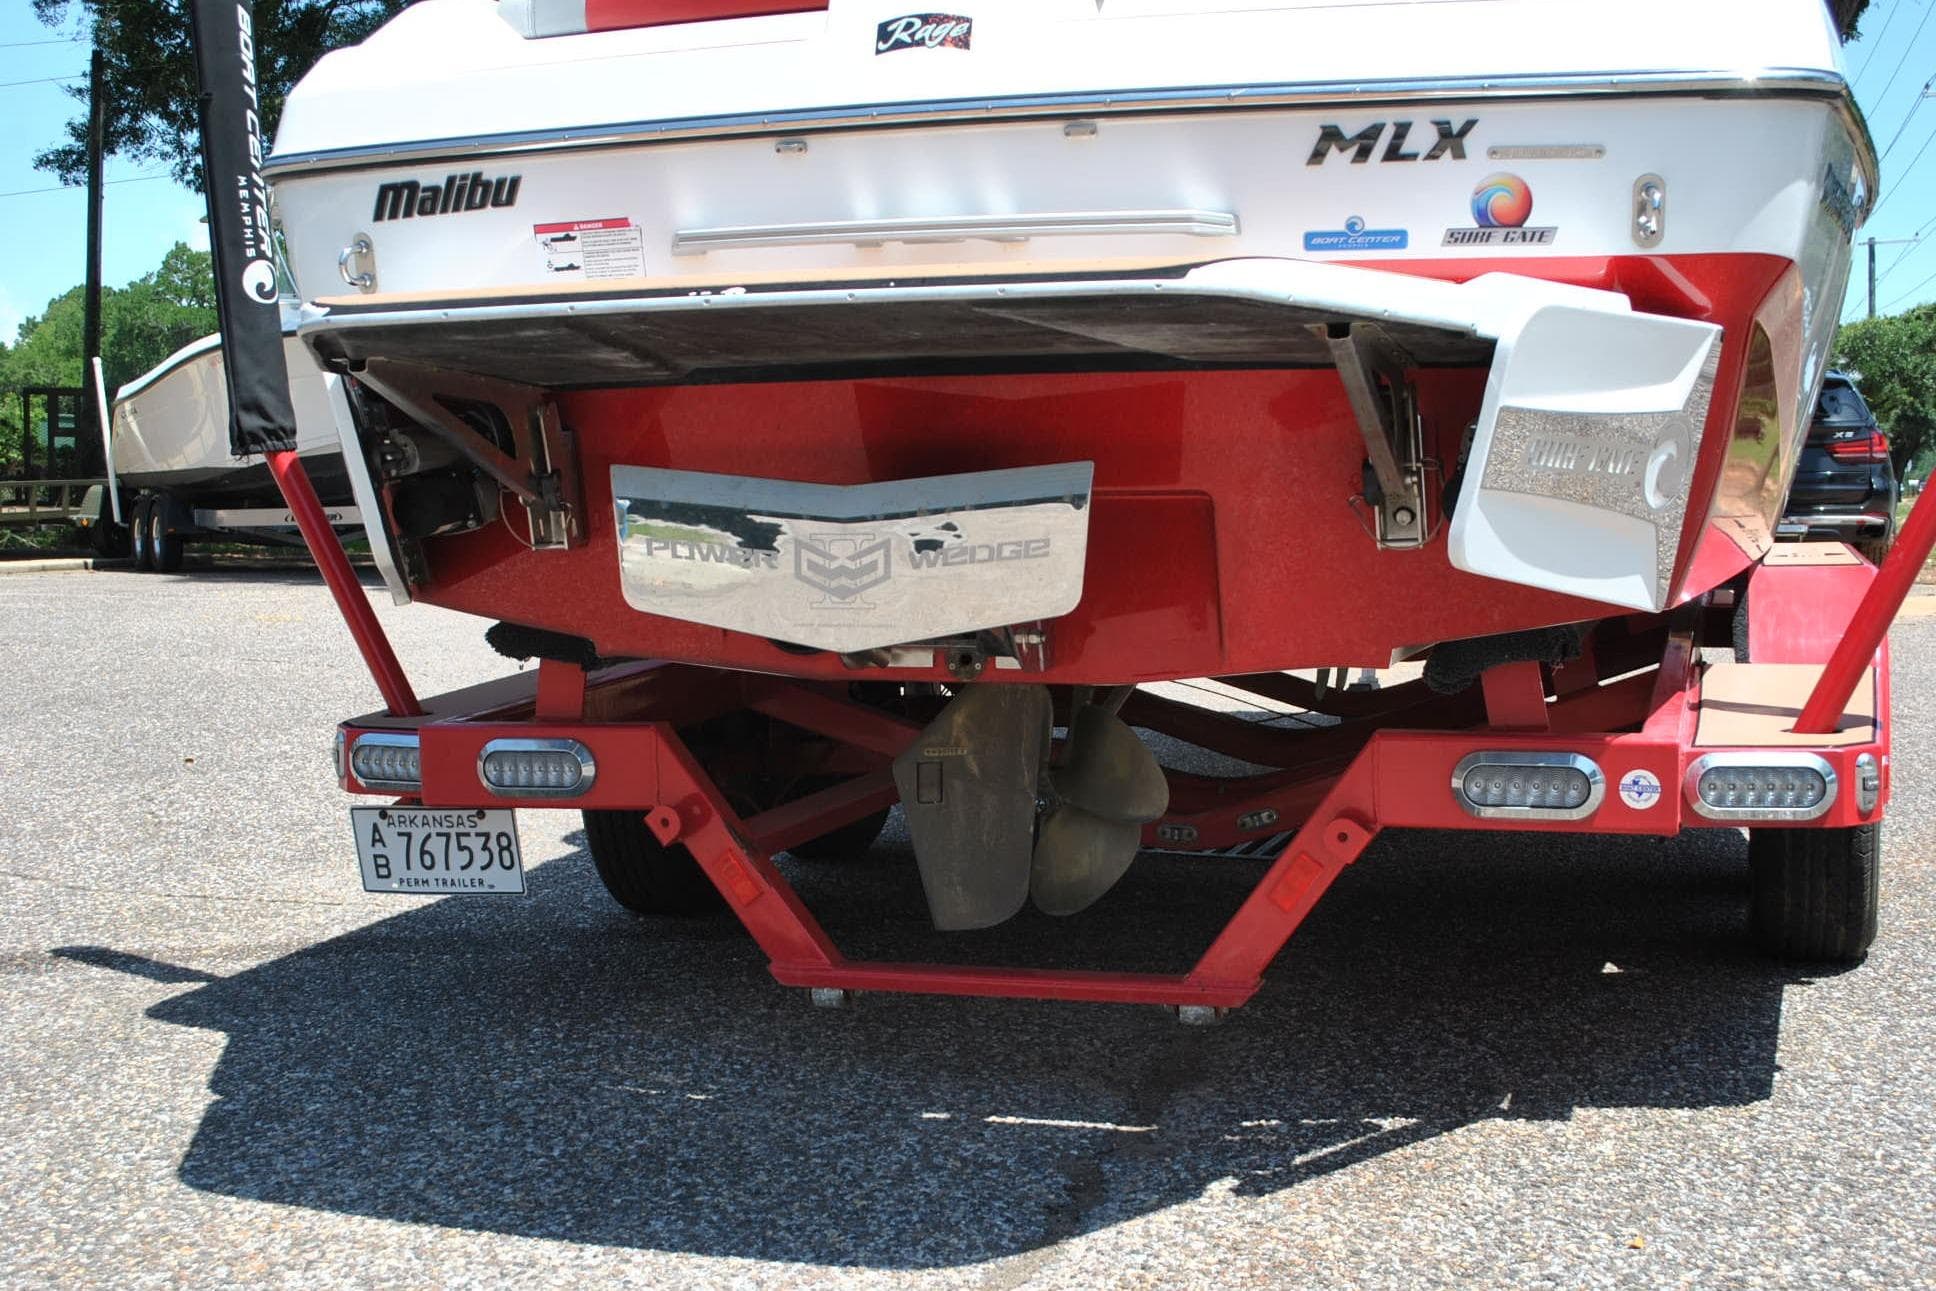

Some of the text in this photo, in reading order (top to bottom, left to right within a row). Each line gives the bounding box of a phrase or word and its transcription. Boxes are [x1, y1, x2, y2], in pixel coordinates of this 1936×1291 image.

[877, 16, 971, 50] Rage
[236, 3, 273, 259] BOAT CENTER
[1305, 118, 1480, 166] MLX
[373, 171, 522, 222] Malibu
[236, 175, 256, 258] MEMPHIS
[1311, 235, 1401, 245] BOAT CENTER
[1447, 230, 1553, 244] SURF GATE
[646, 537, 779, 569] POWER
[908, 538, 1051, 570] WEDGE
[387, 813, 478, 829] ARKANSAS
[397, 831, 515, 871] 767538
[399, 877, 485, 888] PERM TRAILER
